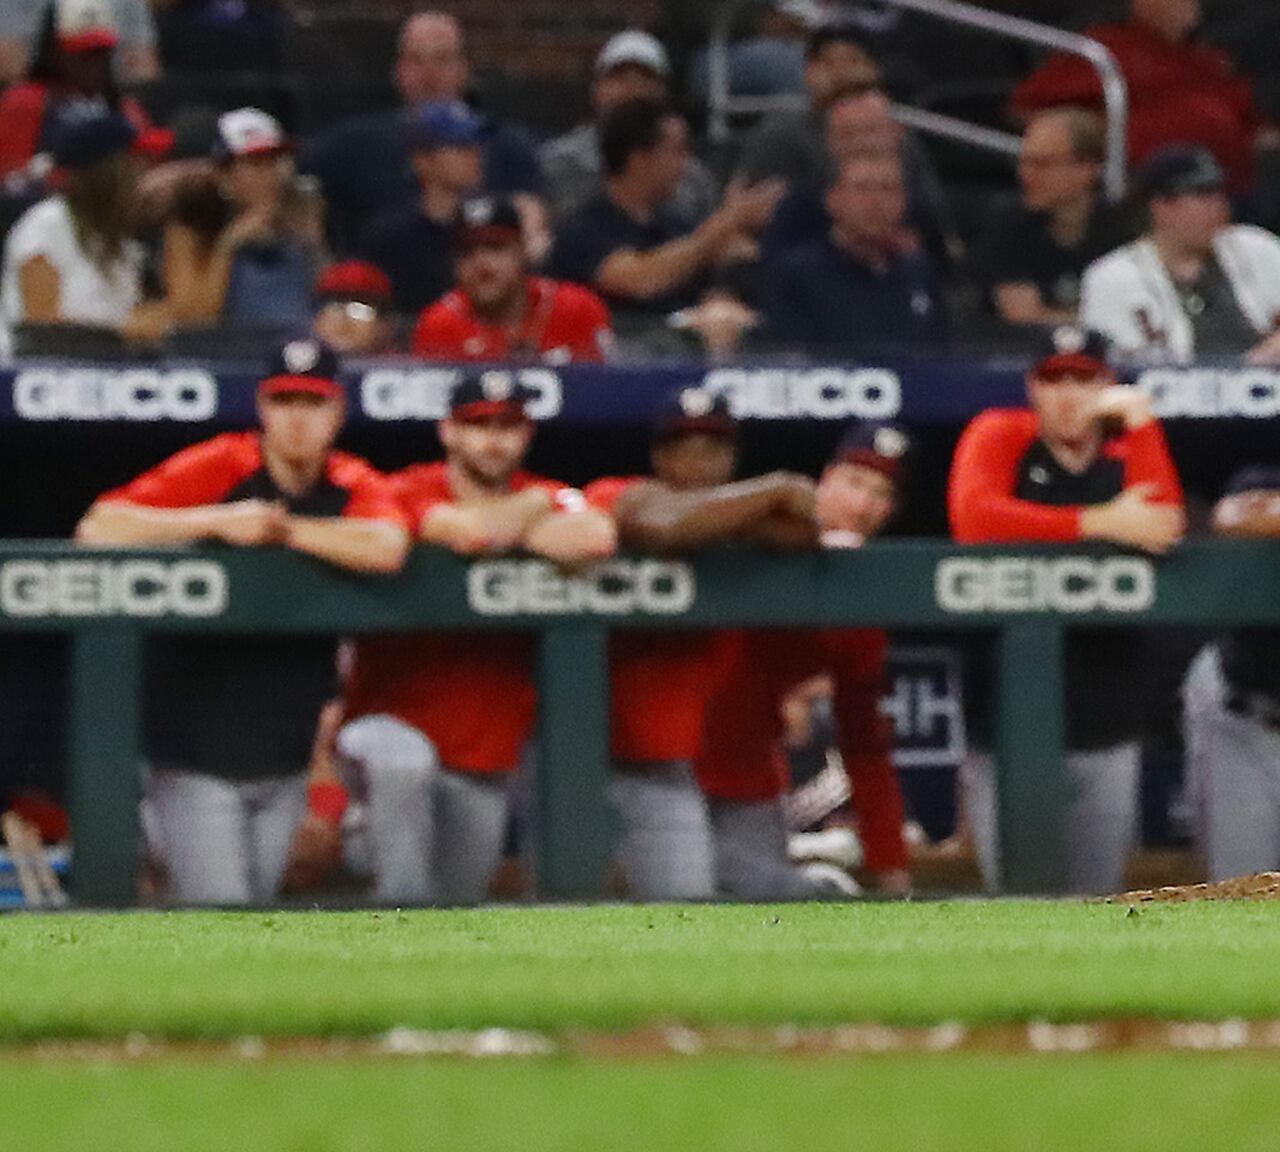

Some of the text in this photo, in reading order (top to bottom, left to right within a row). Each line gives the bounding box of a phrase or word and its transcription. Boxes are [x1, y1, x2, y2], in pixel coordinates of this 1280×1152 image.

[12, 368, 218, 422] GEICO
[361, 368, 564, 420] GEO
[0, 559, 228, 617] GEICO
[467, 557, 696, 616] GEICO
[935, 556, 1156, 613] GEICO
